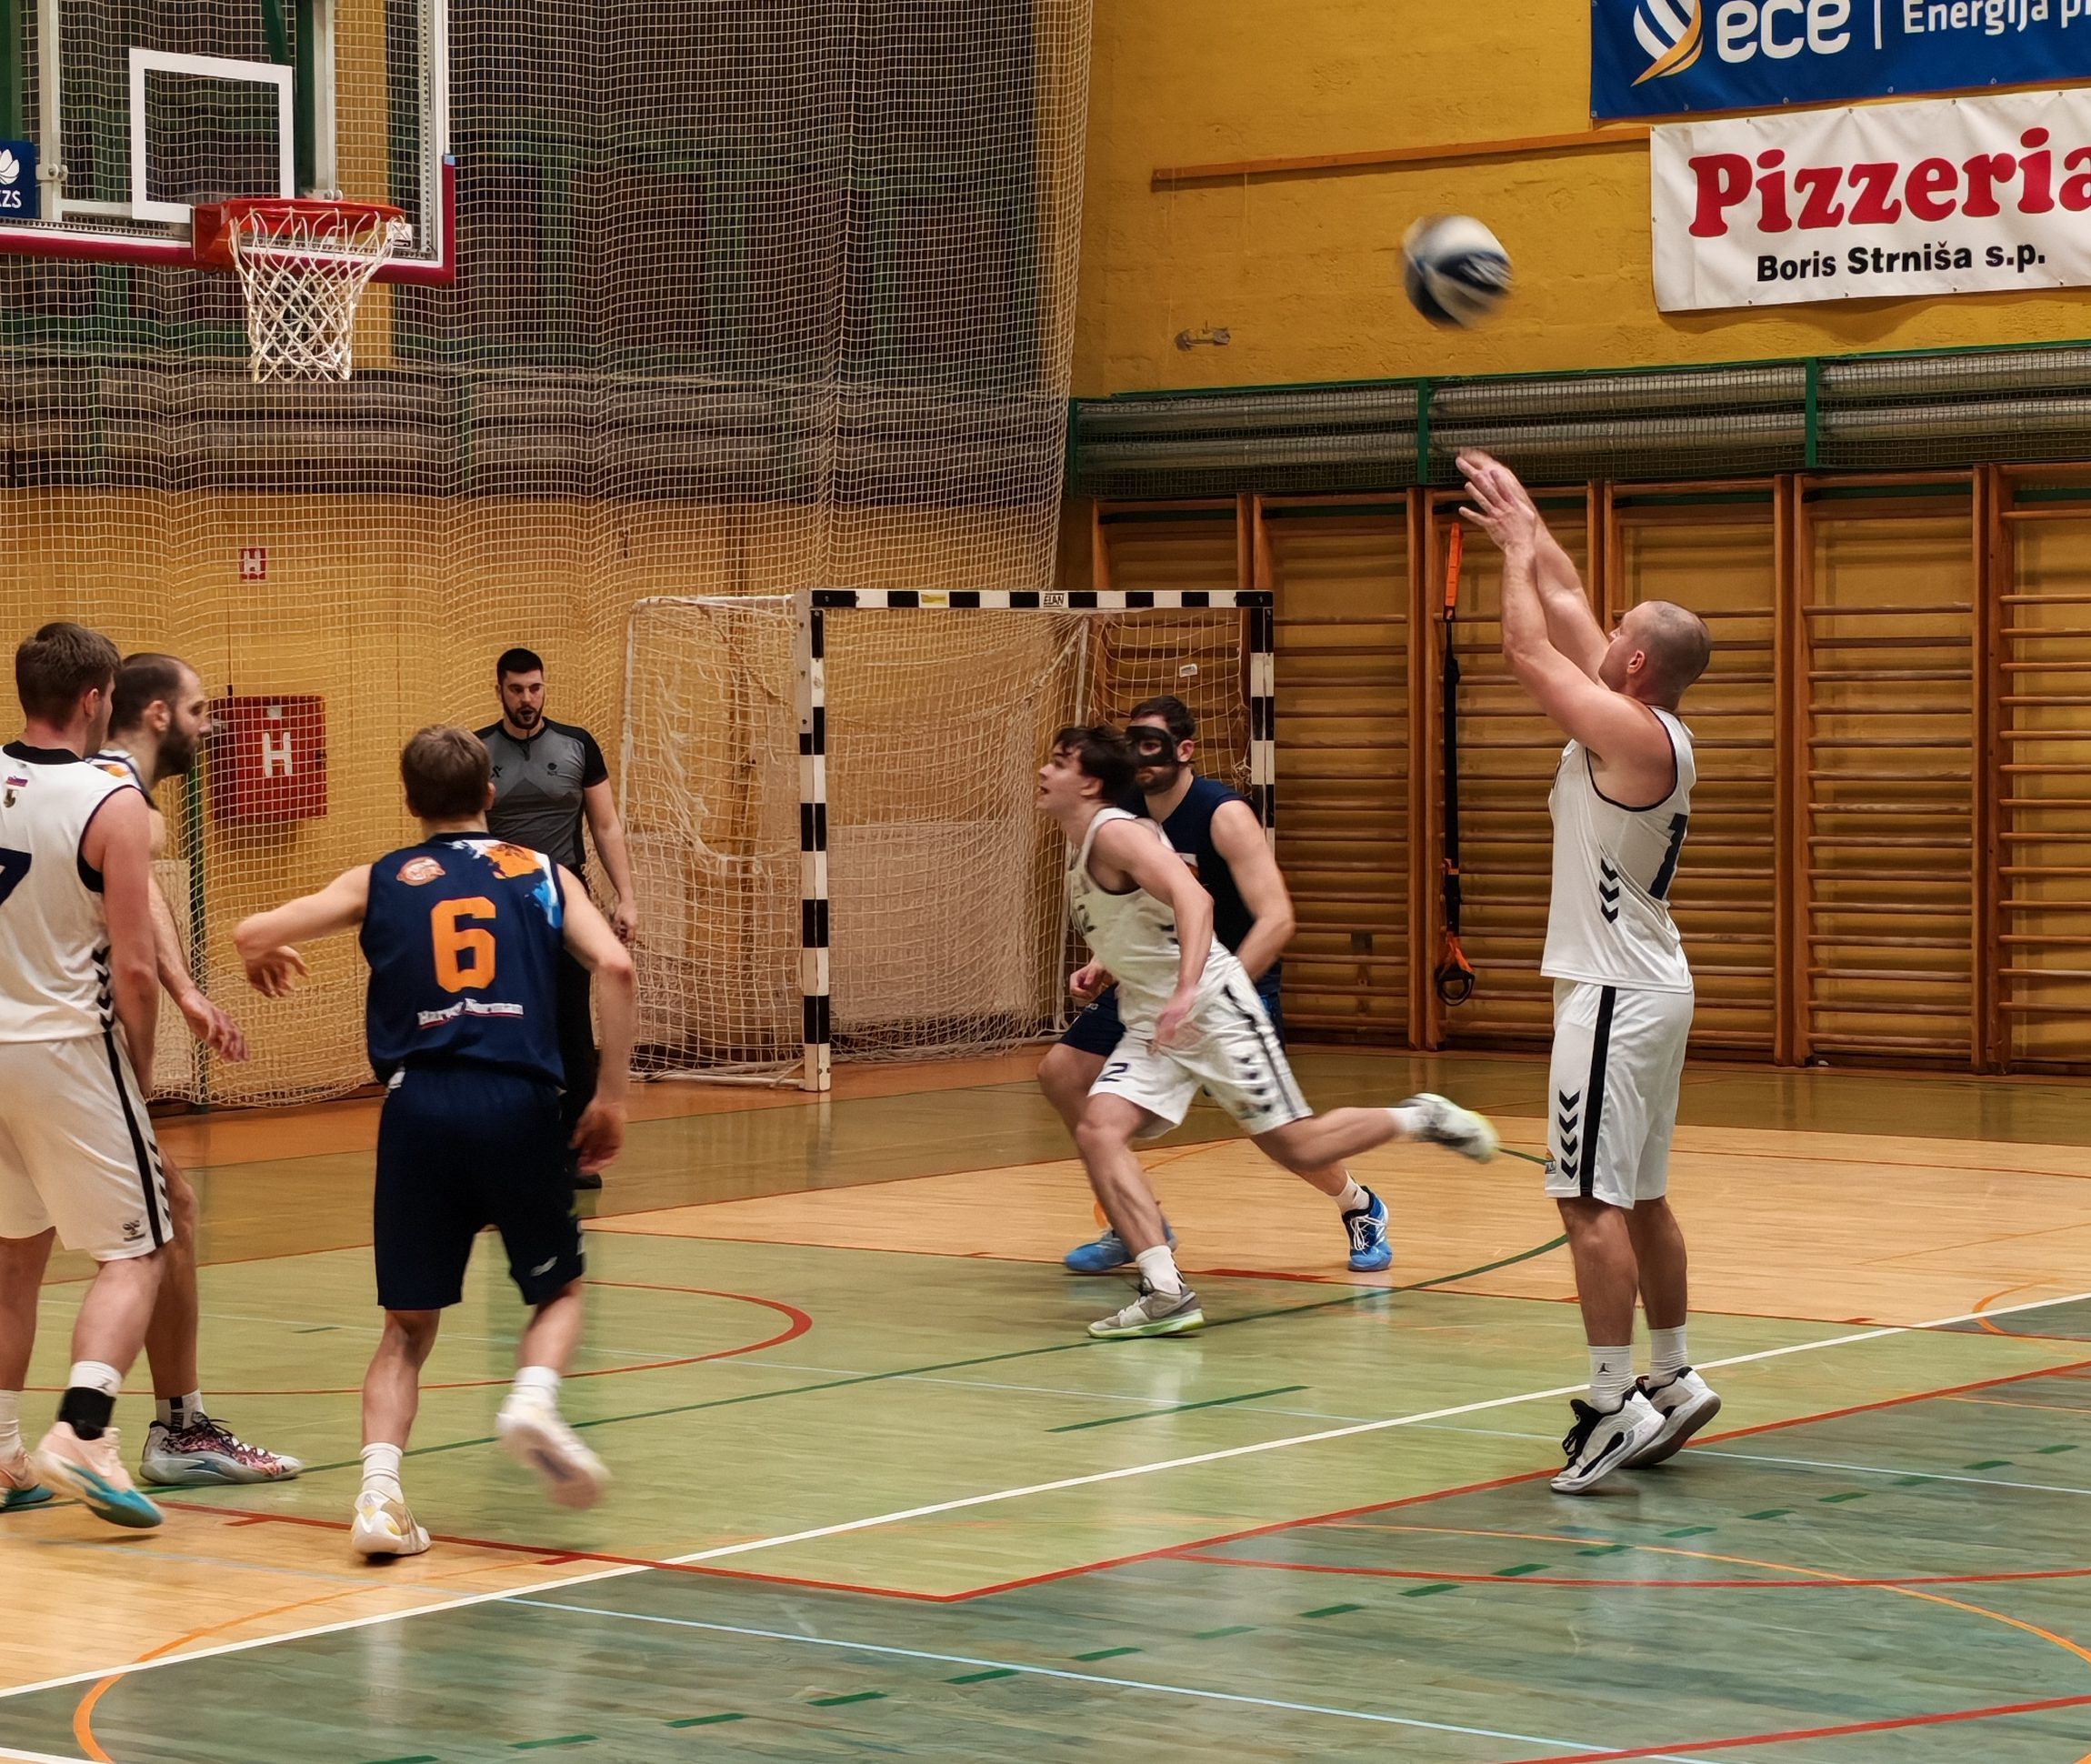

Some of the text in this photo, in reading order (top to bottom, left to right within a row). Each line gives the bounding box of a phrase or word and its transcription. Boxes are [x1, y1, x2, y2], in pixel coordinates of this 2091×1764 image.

[1716, 0, 1850, 63] ece
[2061, 0, 2091, 28] p
[0, 189, 22, 208] ZS
[1688, 127, 2091, 237] Pizzeria
[1756, 240, 2046, 282] Boris Strniša s.p.
[262, 731, 293, 777] H
[430, 896, 496, 993] 6
